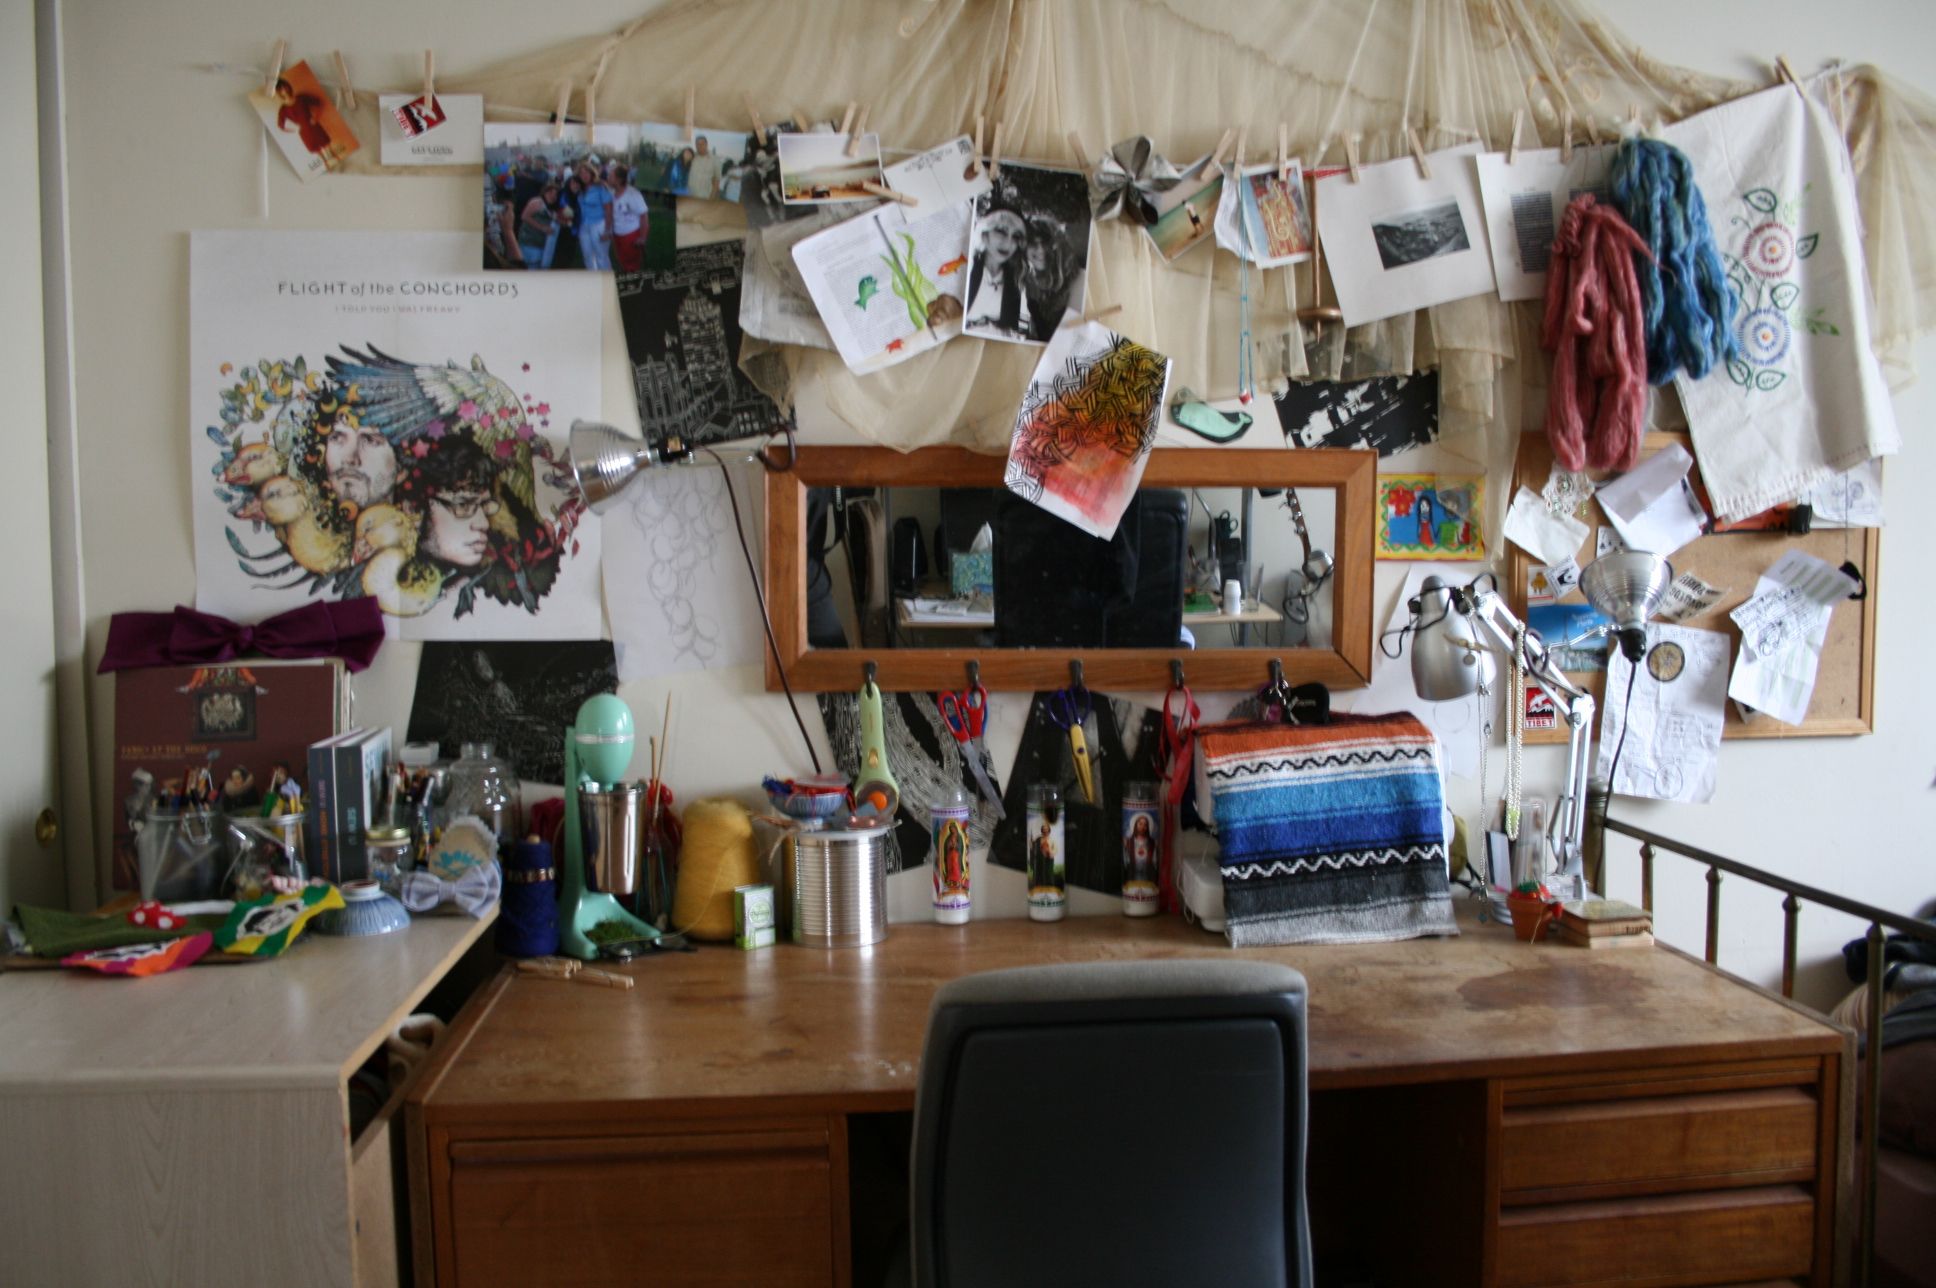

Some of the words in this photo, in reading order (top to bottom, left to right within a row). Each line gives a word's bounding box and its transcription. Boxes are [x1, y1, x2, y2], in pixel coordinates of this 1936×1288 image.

[278, 281, 347, 296] FLIGHT
[351, 283, 365, 297] of
[370, 282, 394, 296] the
[400, 280, 518, 299] CONCHORDS
